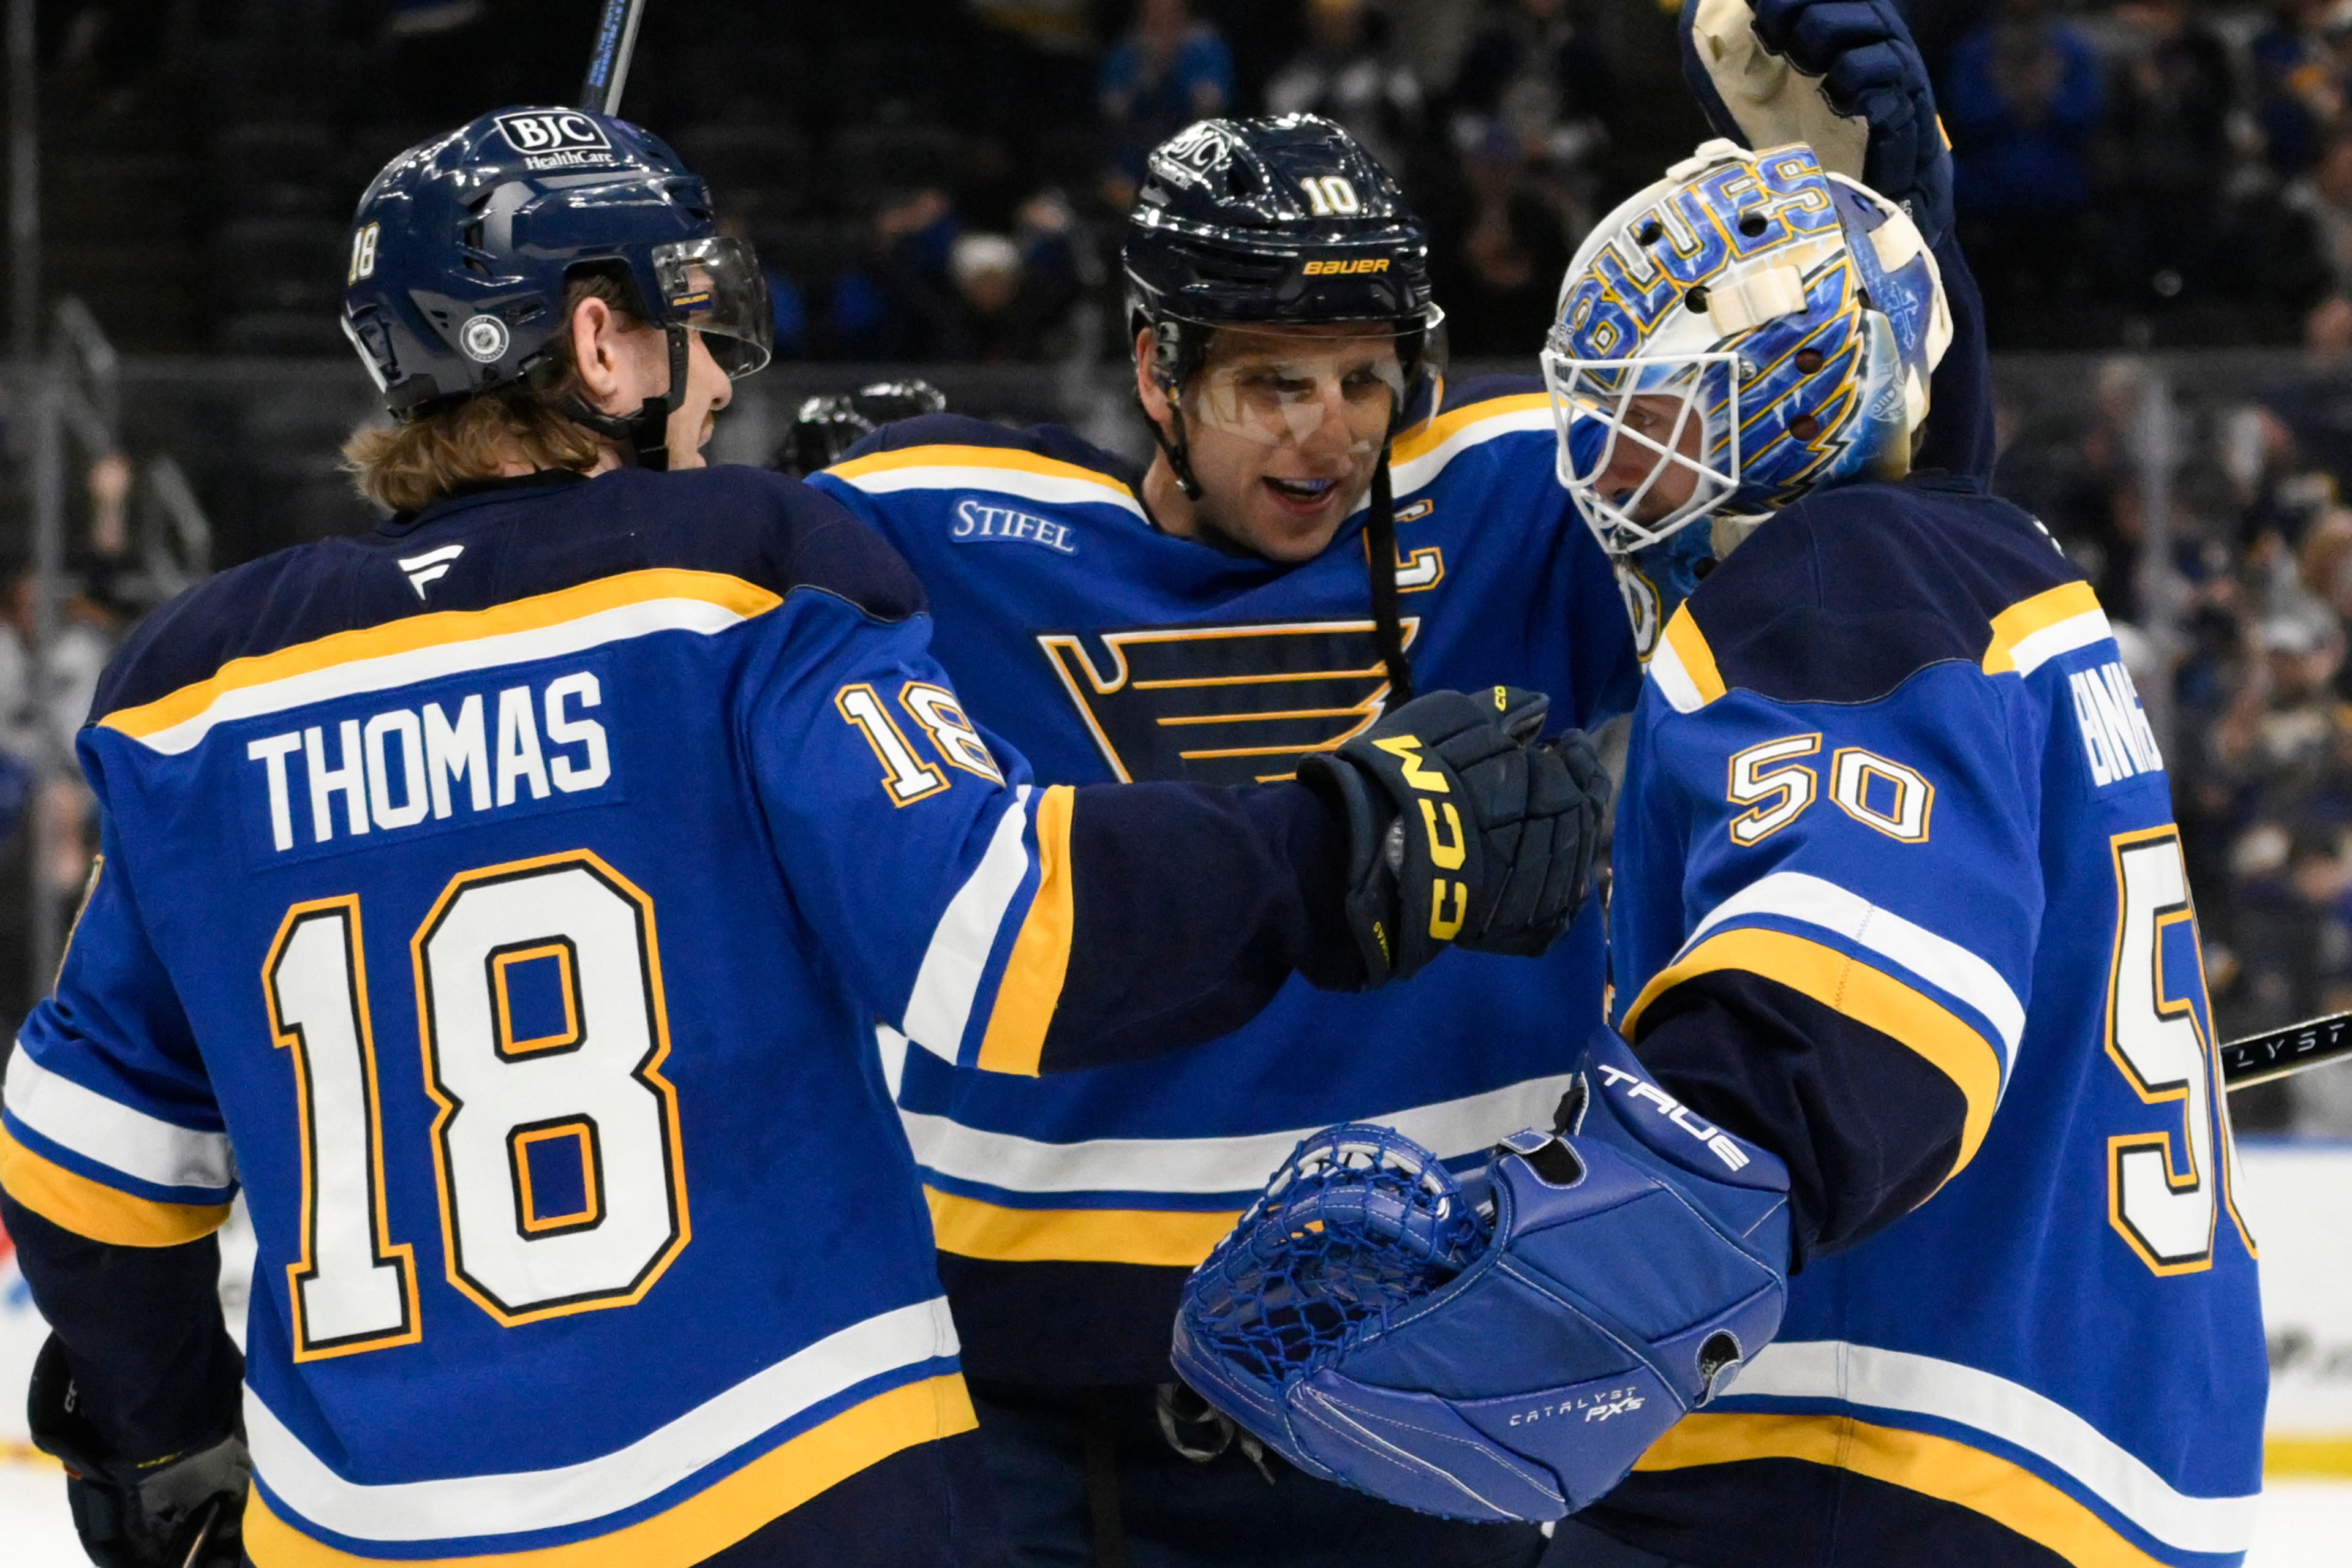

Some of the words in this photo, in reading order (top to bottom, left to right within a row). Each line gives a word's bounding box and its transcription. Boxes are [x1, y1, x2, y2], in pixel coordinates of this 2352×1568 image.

[510, 116, 595, 148] BJC
[524, 151, 614, 170] HealthCare
[1300, 176, 1361, 216] 10
[348, 221, 380, 286] 18
[1303, 258, 1390, 275] BAUER
[1559, 149, 1841, 390] BLUES
[953, 500, 1074, 552] STIFEL
[247, 671, 611, 852] THOMAS
[834, 680, 1008, 809] 18
[1726, 732, 1936, 847] 50
[1371, 734, 1469, 941] CCM
[2104, 823, 2259, 1276] 5
[261, 848, 692, 1363] 18
[1597, 1064, 1751, 1172] TRUE
[1509, 1386, 1637, 1426] CATALYST
